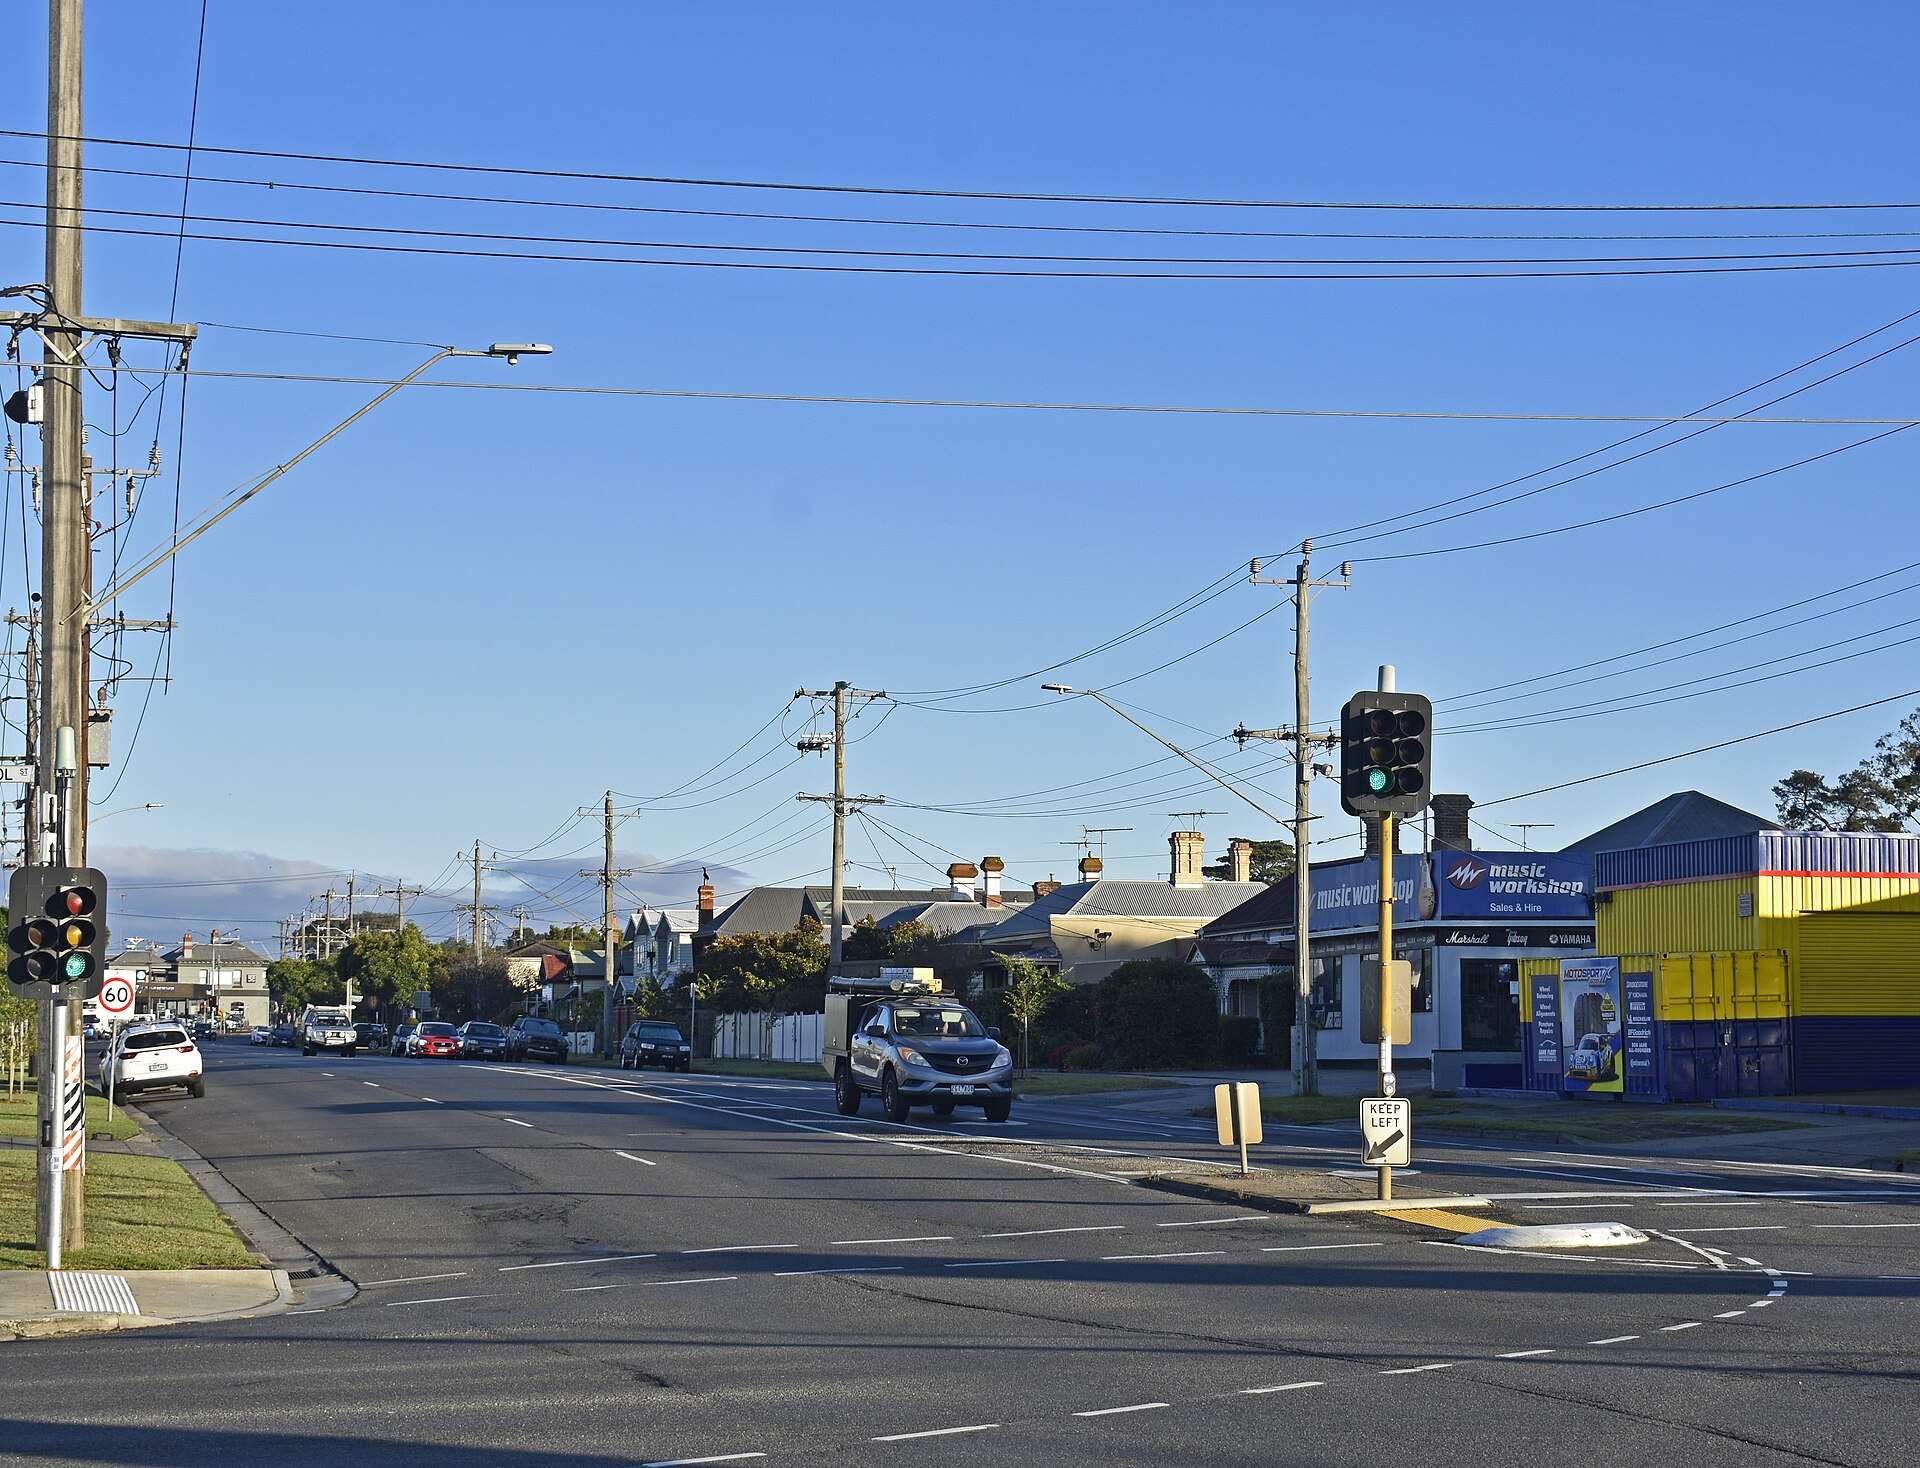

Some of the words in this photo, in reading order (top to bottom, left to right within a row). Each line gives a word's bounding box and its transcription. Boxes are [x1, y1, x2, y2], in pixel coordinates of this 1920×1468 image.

[1489, 862, 1546, 878] music
[1489, 878, 1583, 896] workshop
[1317, 884, 1351, 910] music
[1490, 902, 1514, 912] Sales
[1515, 902, 1522, 912] &
[1524, 903, 1542, 912] Hire
[1445, 930, 1490, 944] Marshall
[1559, 934, 1591, 945] YAMAHA
[105, 987, 128, 1003] 60
[1370, 1104, 1401, 1114] KEEP
[1371, 1117, 1400, 1128] LEFT
